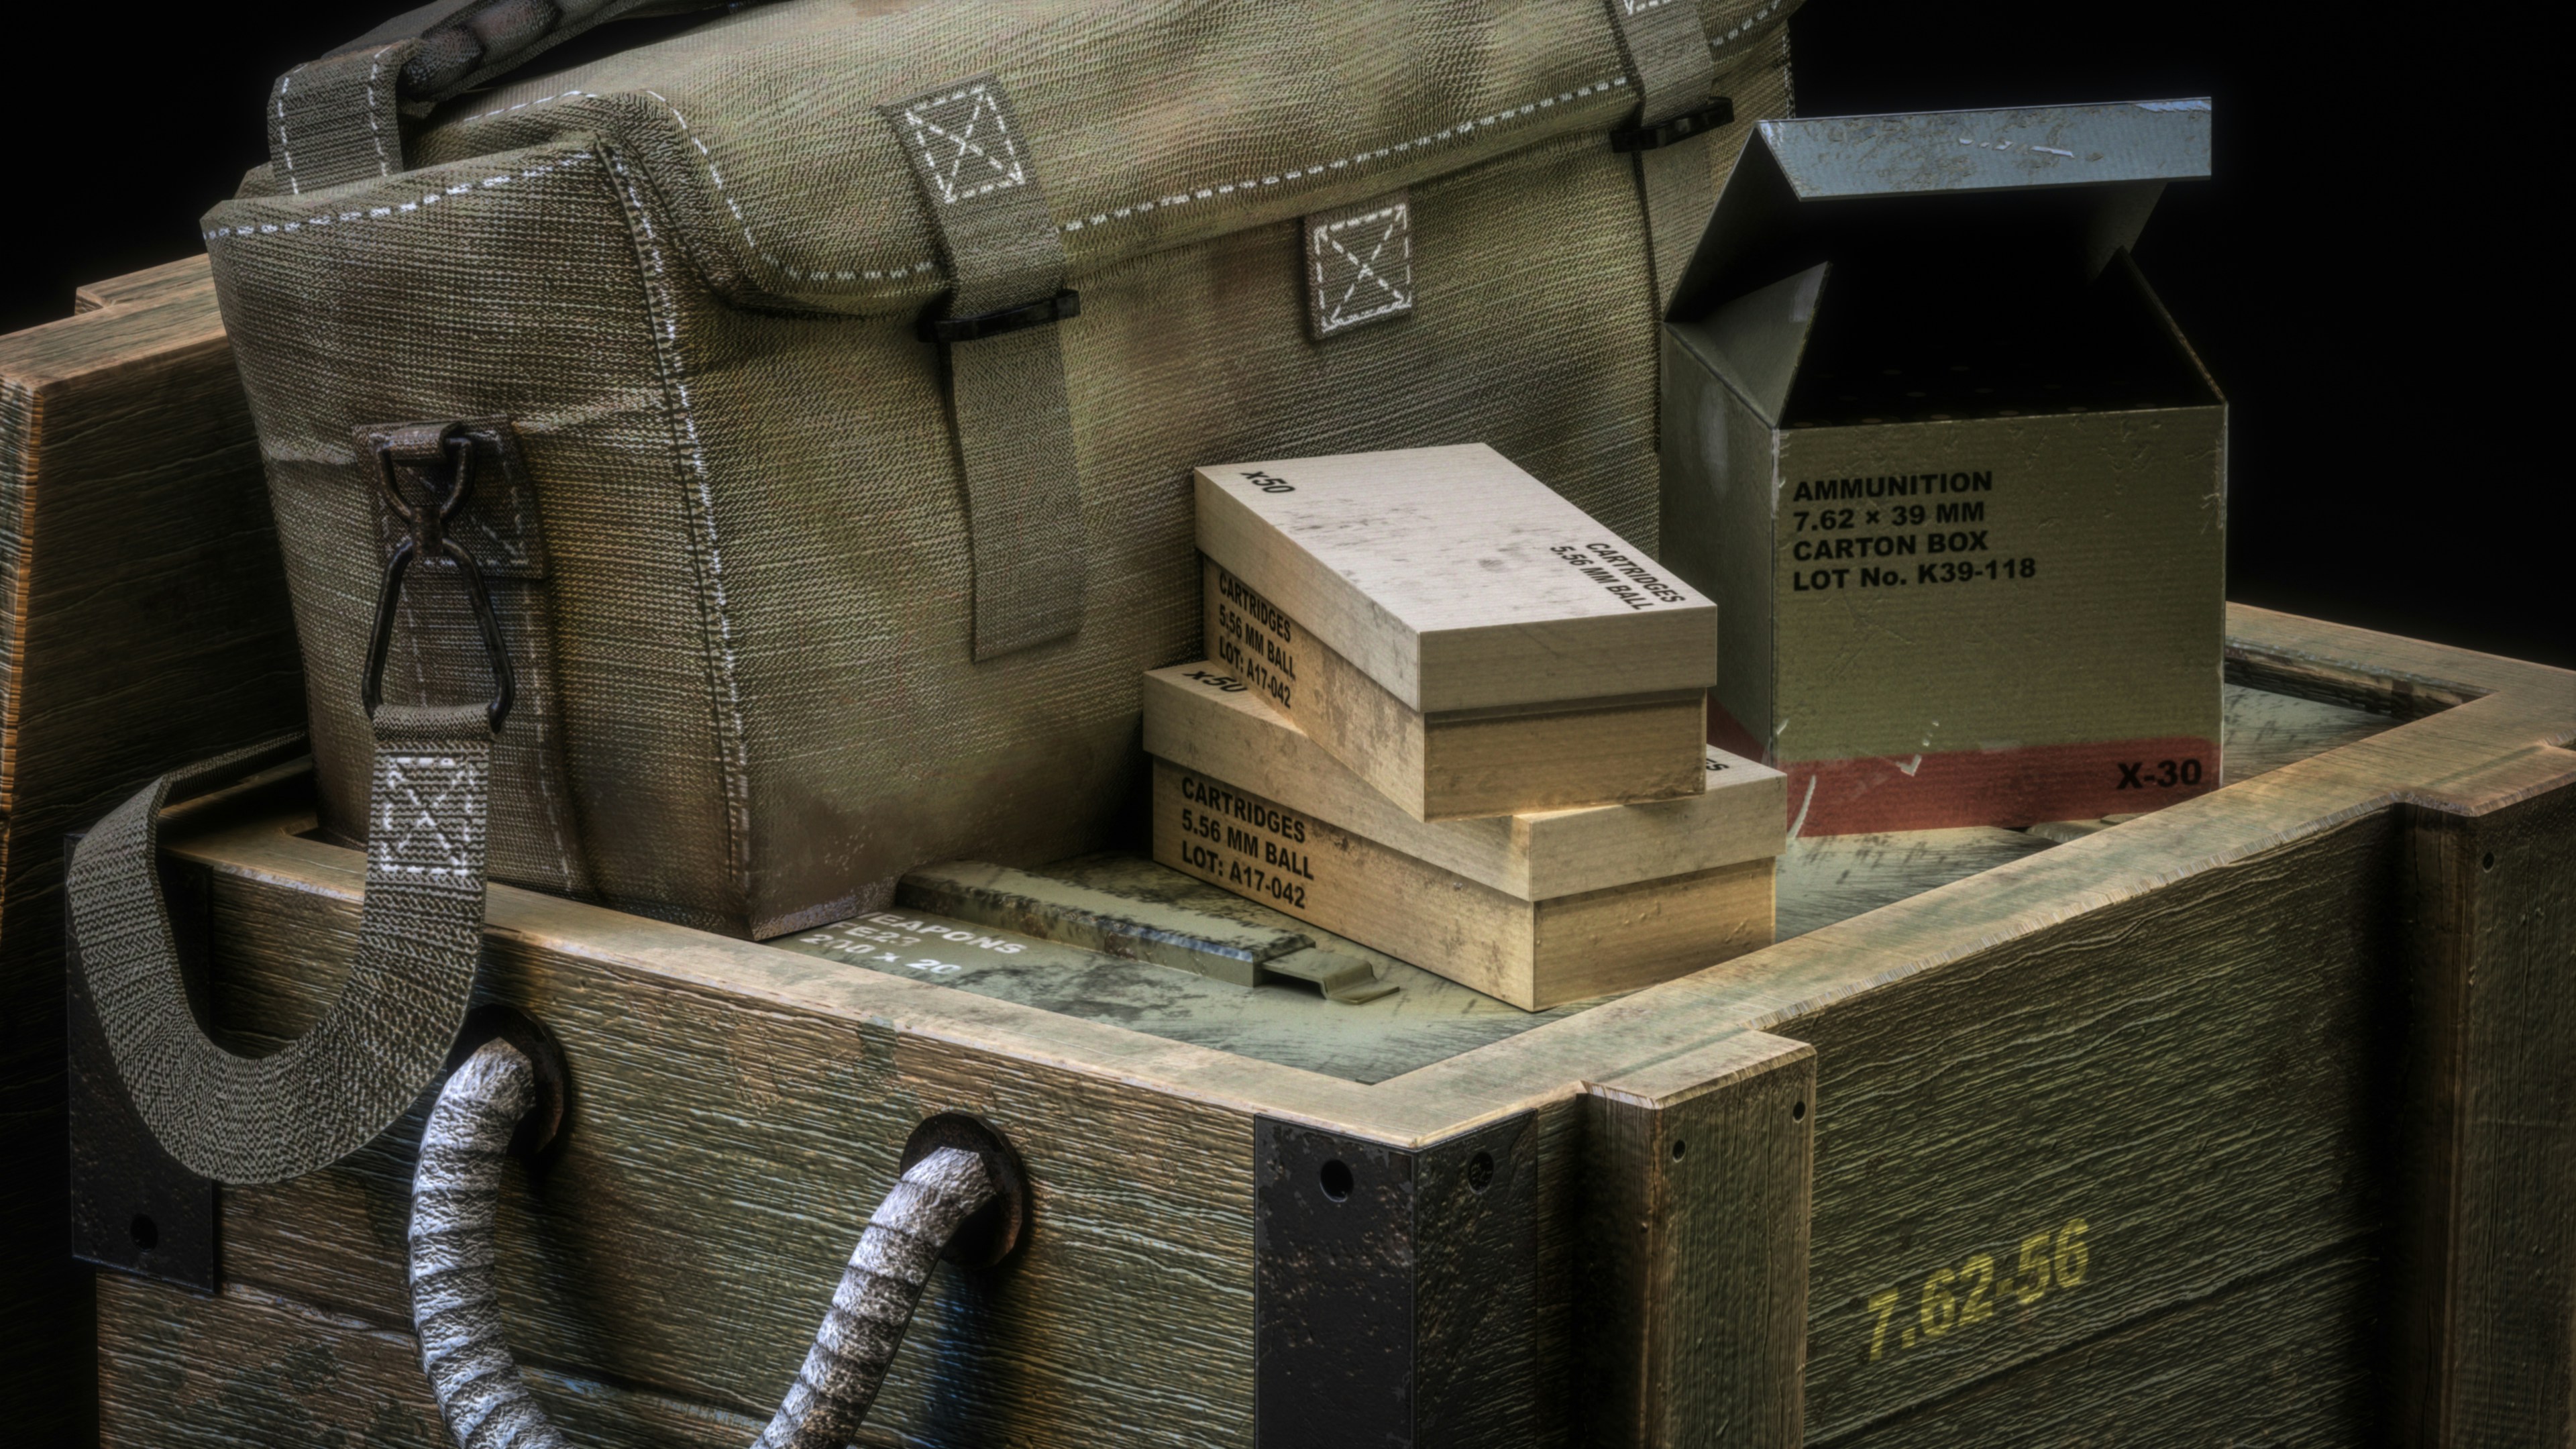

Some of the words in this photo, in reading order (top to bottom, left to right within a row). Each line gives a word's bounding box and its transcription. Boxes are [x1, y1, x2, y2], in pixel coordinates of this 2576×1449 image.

[1240, 471, 1295, 493] x50
[1793, 471, 1992, 502] AMMUNITION
[1793, 508, 1856, 532] 7.62
[1892, 504, 1925, 527] 39
[1936, 501, 1984, 524] MM
[1793, 535, 1916, 561] CARTON
[1927, 530, 1988, 553] BOX
[1550, 545, 1594, 566] 5.56
[1579, 567, 1620, 584] MM
[1605, 585, 1654, 610] BALL
[1585, 543, 1686, 602] CARTRIDGES
[1793, 569, 1850, 591] LOT
[1860, 567, 1907, 587] No.
[1918, 557, 2035, 584] K39-118
[1219, 572, 1291, 643] CARTRIDGES
[1219, 603, 1242, 640] 5.56
[1245, 623, 1264, 656] MM
[1267, 639, 1295, 682] BALL
[1219, 635, 1244, 674] LOT:
[1246, 657, 1291, 709] A17-042
[2116, 759, 2202, 790] X-30
[1181, 777, 1305, 843] CARTRIDGES
[1181, 808, 1221, 843] 5.56
[1227, 826, 1258, 859] MM
[1265, 841, 1314, 881] BALL
[1182, 840, 1223, 877] LOT:
[1229, 860, 1305, 910] A17-042
[906, 959, 962, 974] 20
[1868, 1218, 2089, 1362] 7.62-56
